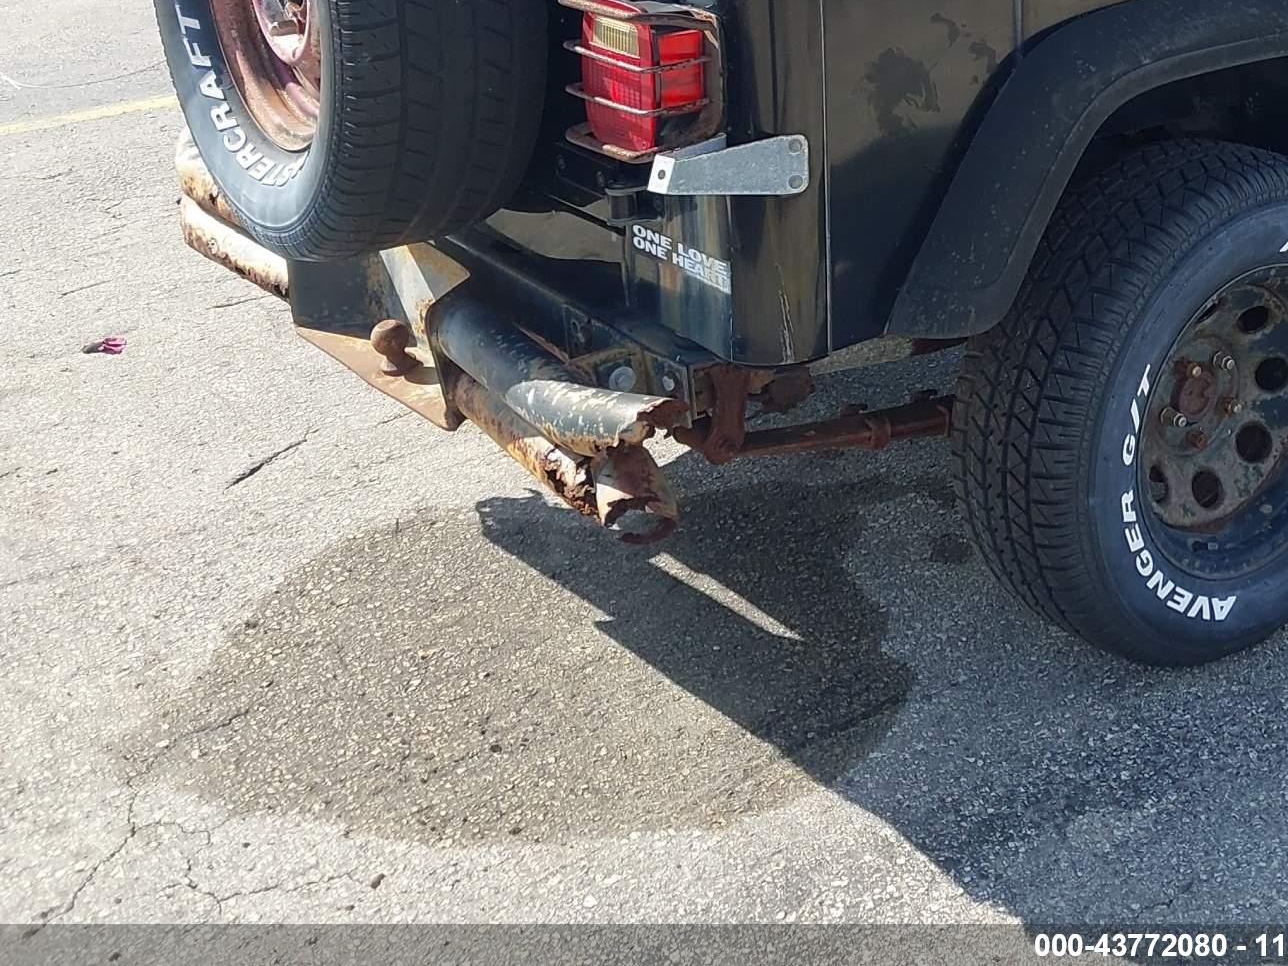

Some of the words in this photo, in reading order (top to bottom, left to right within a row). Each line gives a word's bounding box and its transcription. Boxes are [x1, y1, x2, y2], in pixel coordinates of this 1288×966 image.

[632, 224, 673, 250] ONE
[677, 242, 728, 276] LOVE
[632, 237, 668, 260] ONE
[672, 252, 731, 294] HEART
[1122, 363, 1152, 467] G/T
[1121, 488, 1237, 622] AVENGER
